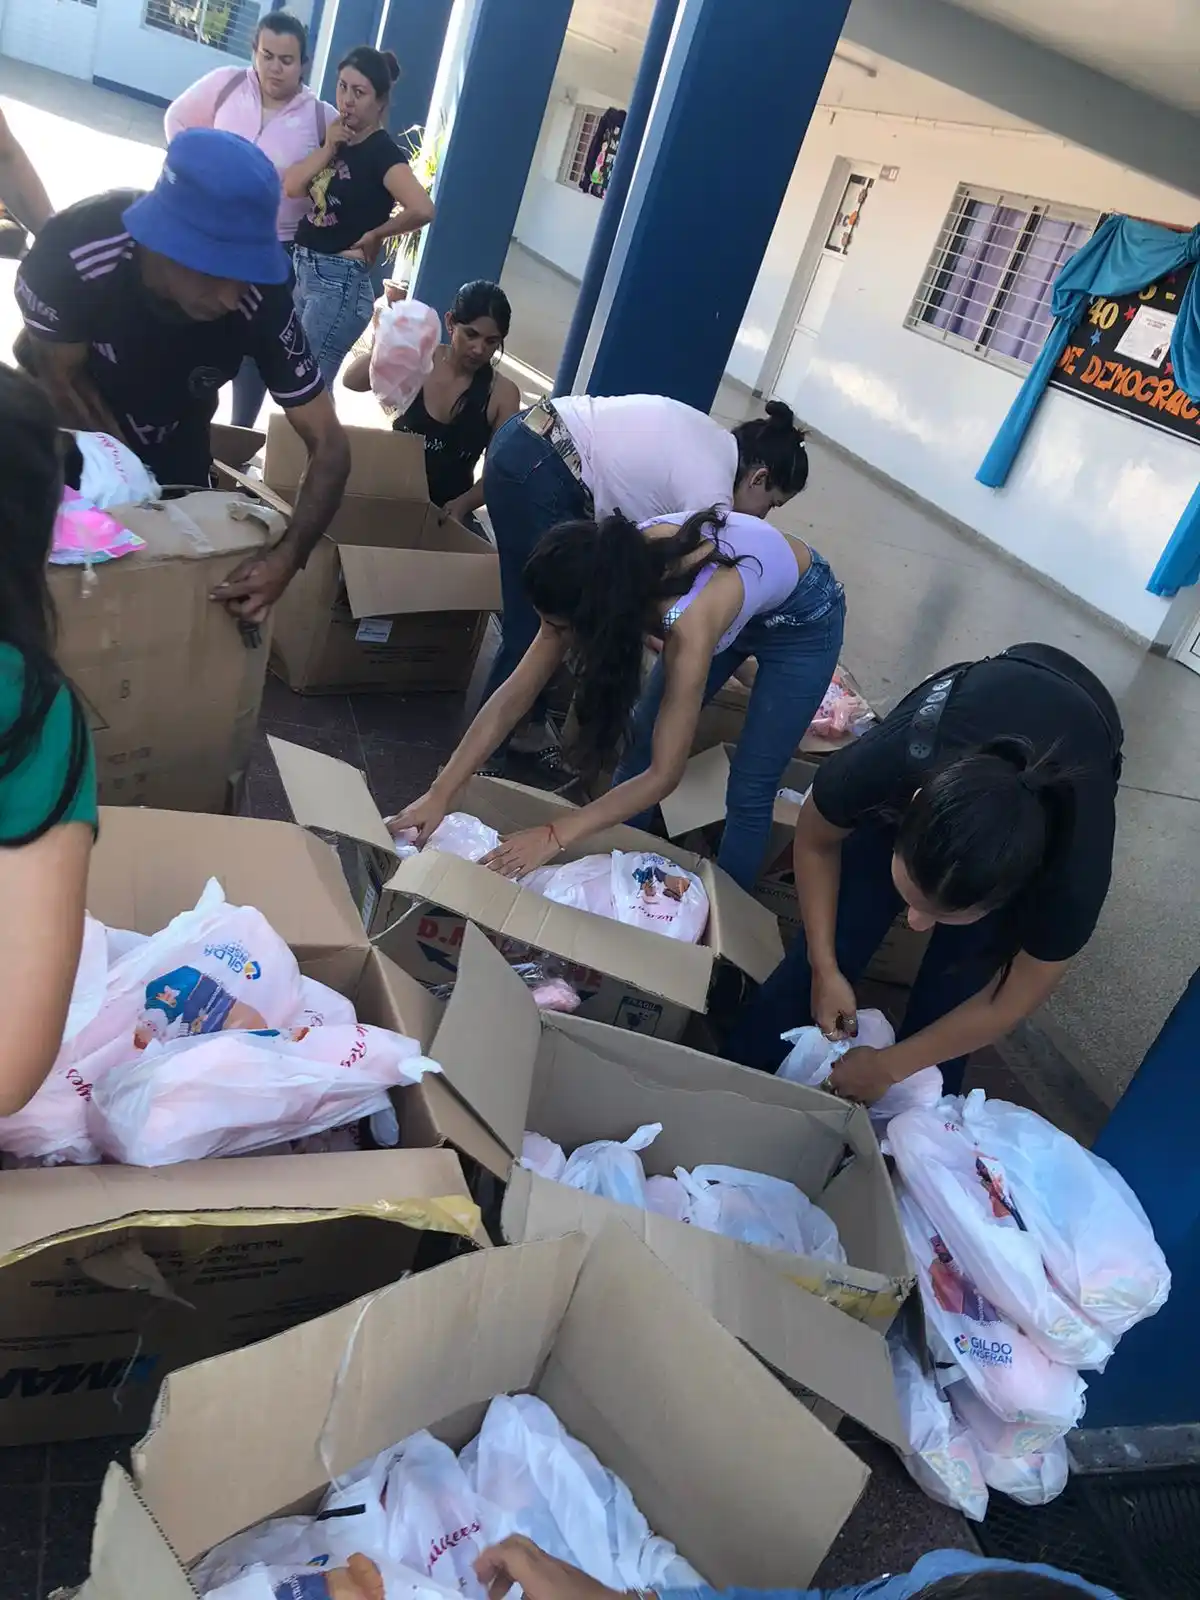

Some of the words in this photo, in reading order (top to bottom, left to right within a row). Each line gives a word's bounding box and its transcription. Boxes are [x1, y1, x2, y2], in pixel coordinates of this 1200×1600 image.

[1088, 296, 1119, 330] 40
[1079, 354, 1200, 426] DEMOCRAC
[970, 1336, 1012, 1355] GILDO
